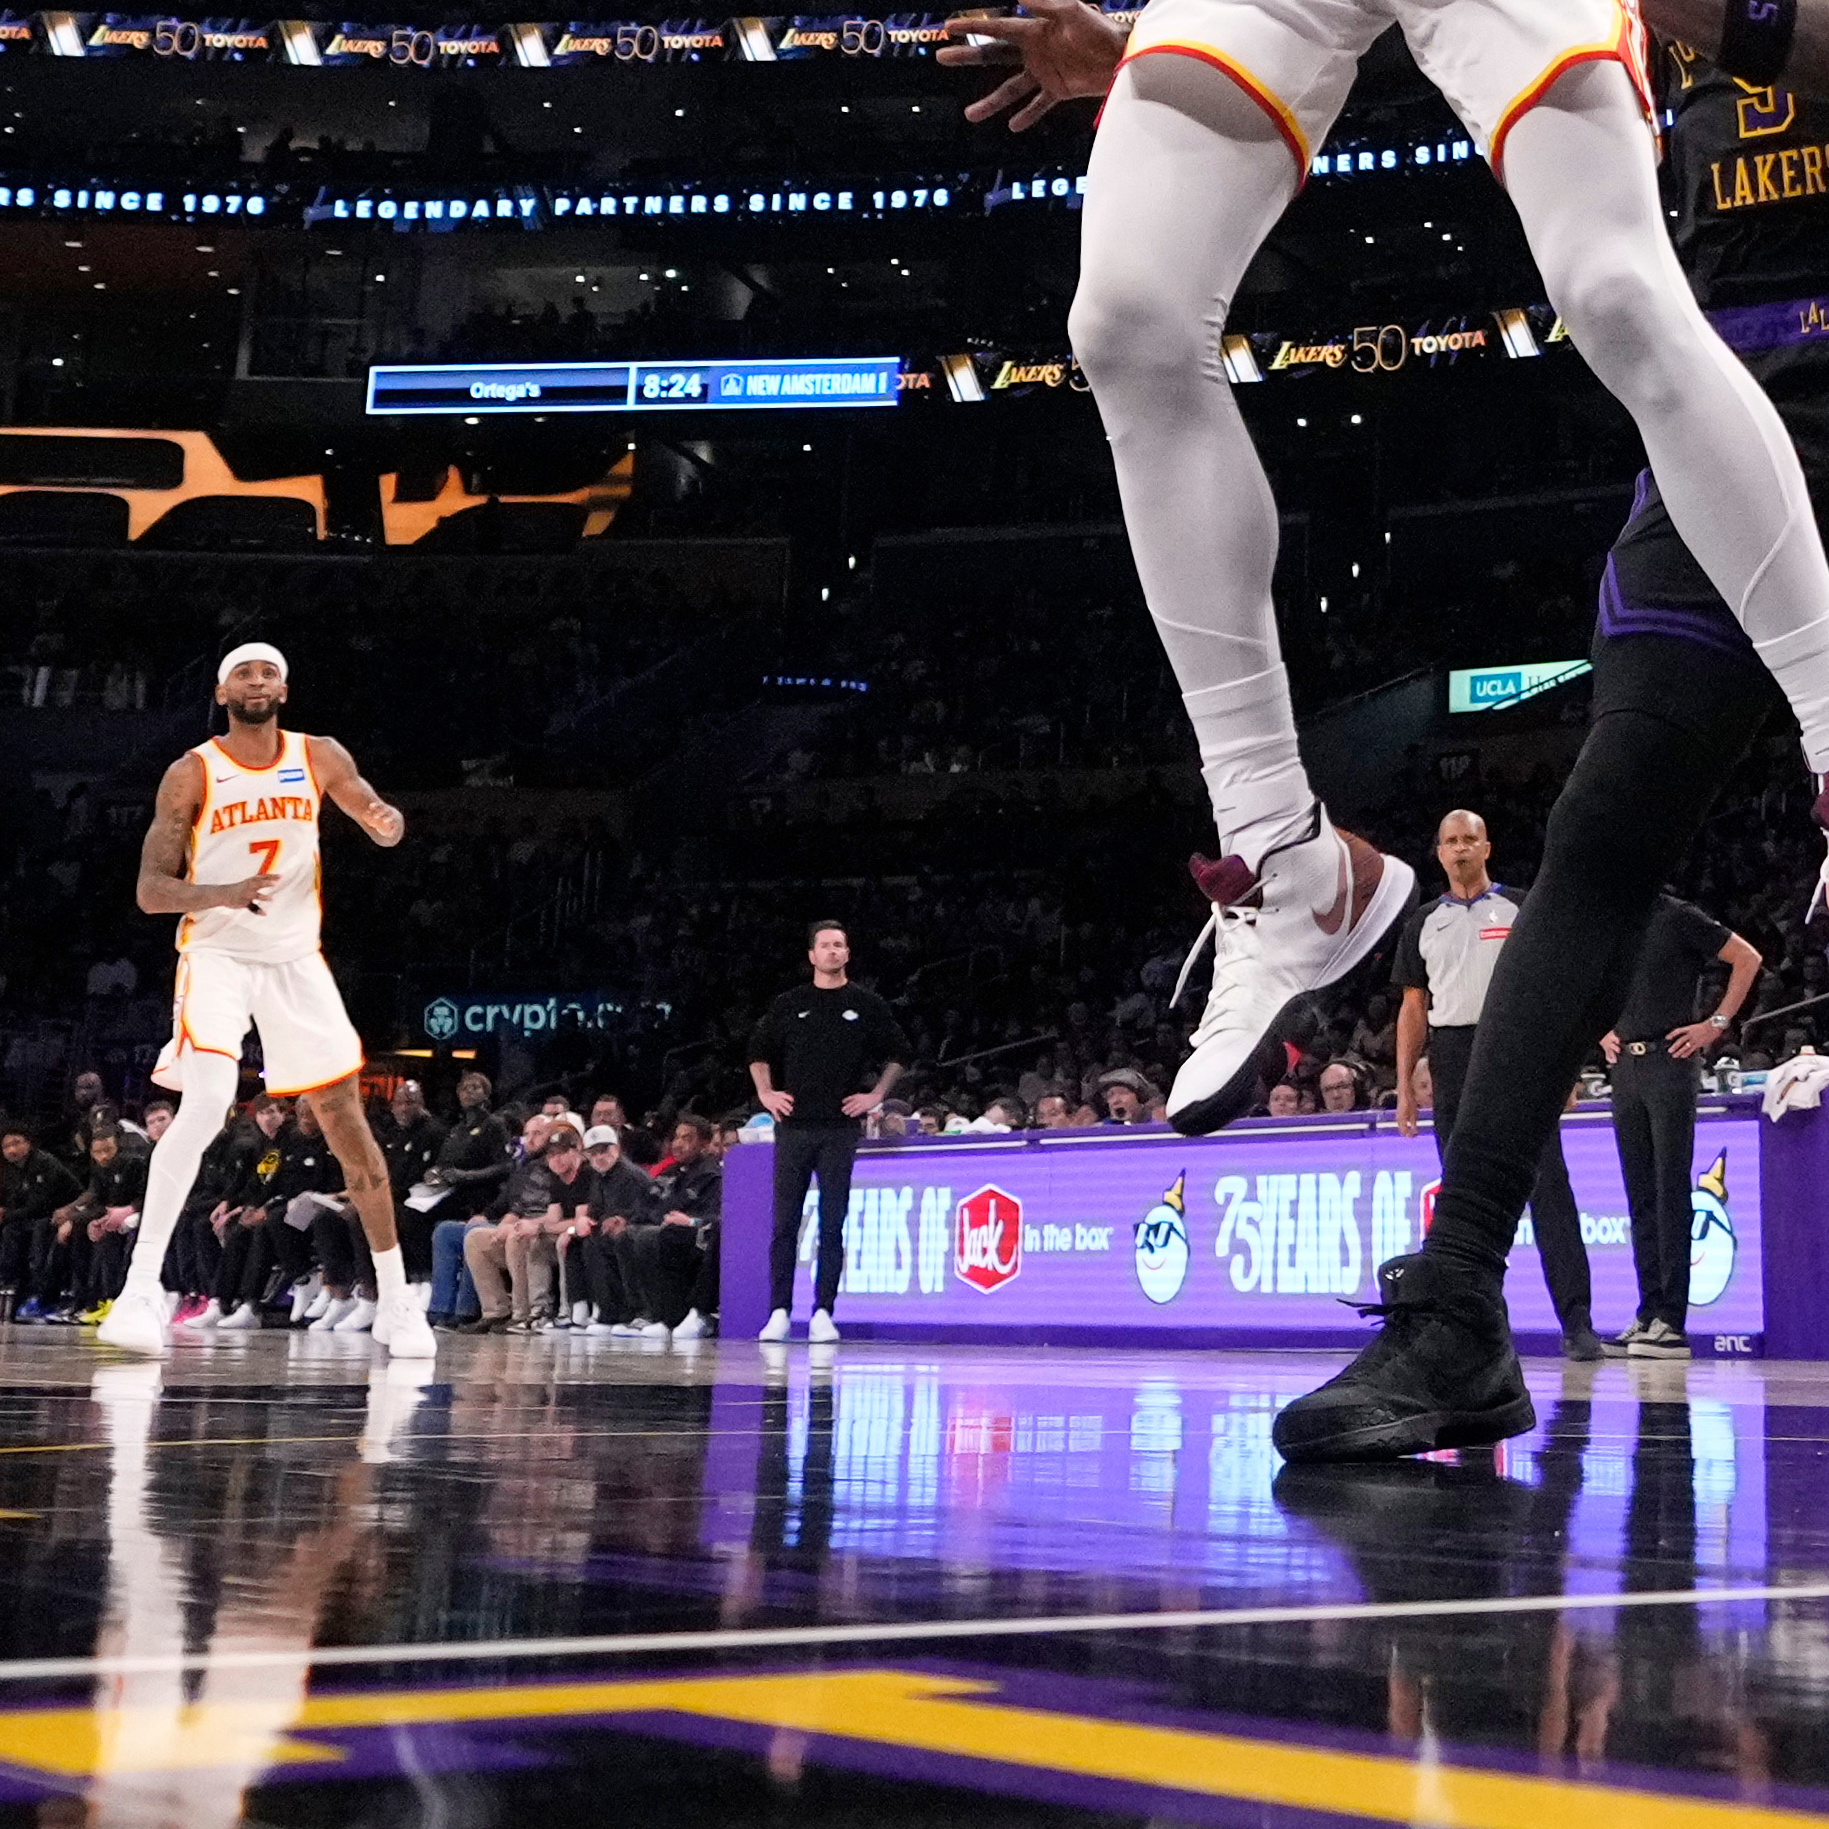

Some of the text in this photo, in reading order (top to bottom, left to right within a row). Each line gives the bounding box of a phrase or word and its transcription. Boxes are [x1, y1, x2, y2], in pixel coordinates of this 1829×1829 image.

[152, 20, 201, 57] 50
[204, 33, 268, 51] TOYOTA
[387, 28, 435, 65] 50
[437, 37, 500, 56] TOYOTA
[614, 25, 659, 61] 50
[662, 33, 723, 52] TOYOTA
[841, 20, 886, 56] 50
[53, 188, 164, 213] SINCE
[182, 192, 266, 215] 1976
[334, 187, 951, 219] LEGENDARY PARTNERS SINCE 1976
[1271, 324, 1485, 373] LAKERS 50 TOYOTA
[470, 380, 541, 401] Ortega's
[643, 373, 702, 399] 8:24
[746, 375, 781, 396] NEW
[781, 372, 876, 396] AMSTERDAM
[991, 360, 1065, 388] LAKERS
[1475, 678, 1517, 697] UCLA
[210, 795, 313, 835] ATLANTA
[249, 839, 284, 876] 7
[920, 1185, 952, 1295] OF
[958, 1202, 1018, 1276] Jack
[1024, 1225, 1040, 1251] in
[1042, 1225, 1072, 1251] the
[1076, 1226, 1111, 1252] box
[1214, 1176, 1264, 1295] 75
[1256, 1171, 1362, 1295] YEARS
[1372, 1170, 1413, 1282] OF
[1714, 1334, 1753, 1354] anc
